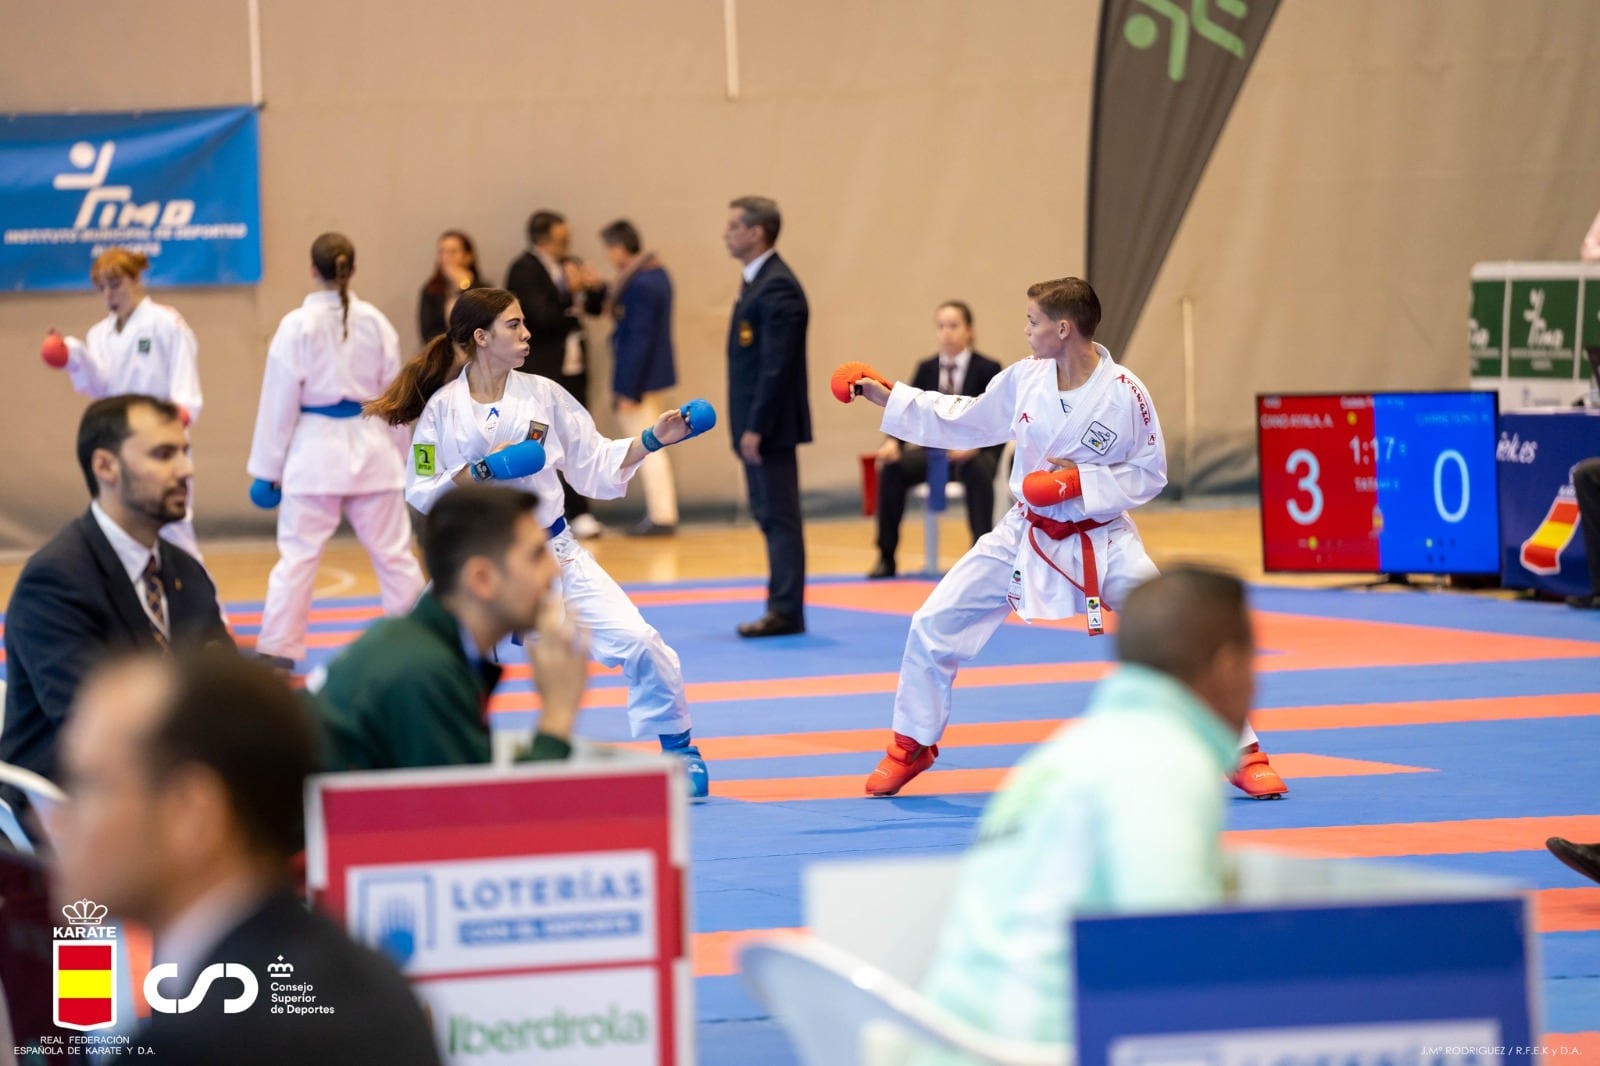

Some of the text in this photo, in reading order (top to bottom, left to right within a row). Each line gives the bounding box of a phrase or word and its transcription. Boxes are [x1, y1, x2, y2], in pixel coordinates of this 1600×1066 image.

[1285, 448, 1324, 525] 3
[1433, 449, 1471, 523] 0
[452, 866, 643, 911] LOTERÍAS
[449, 1003, 648, 1057] Iberdrola
